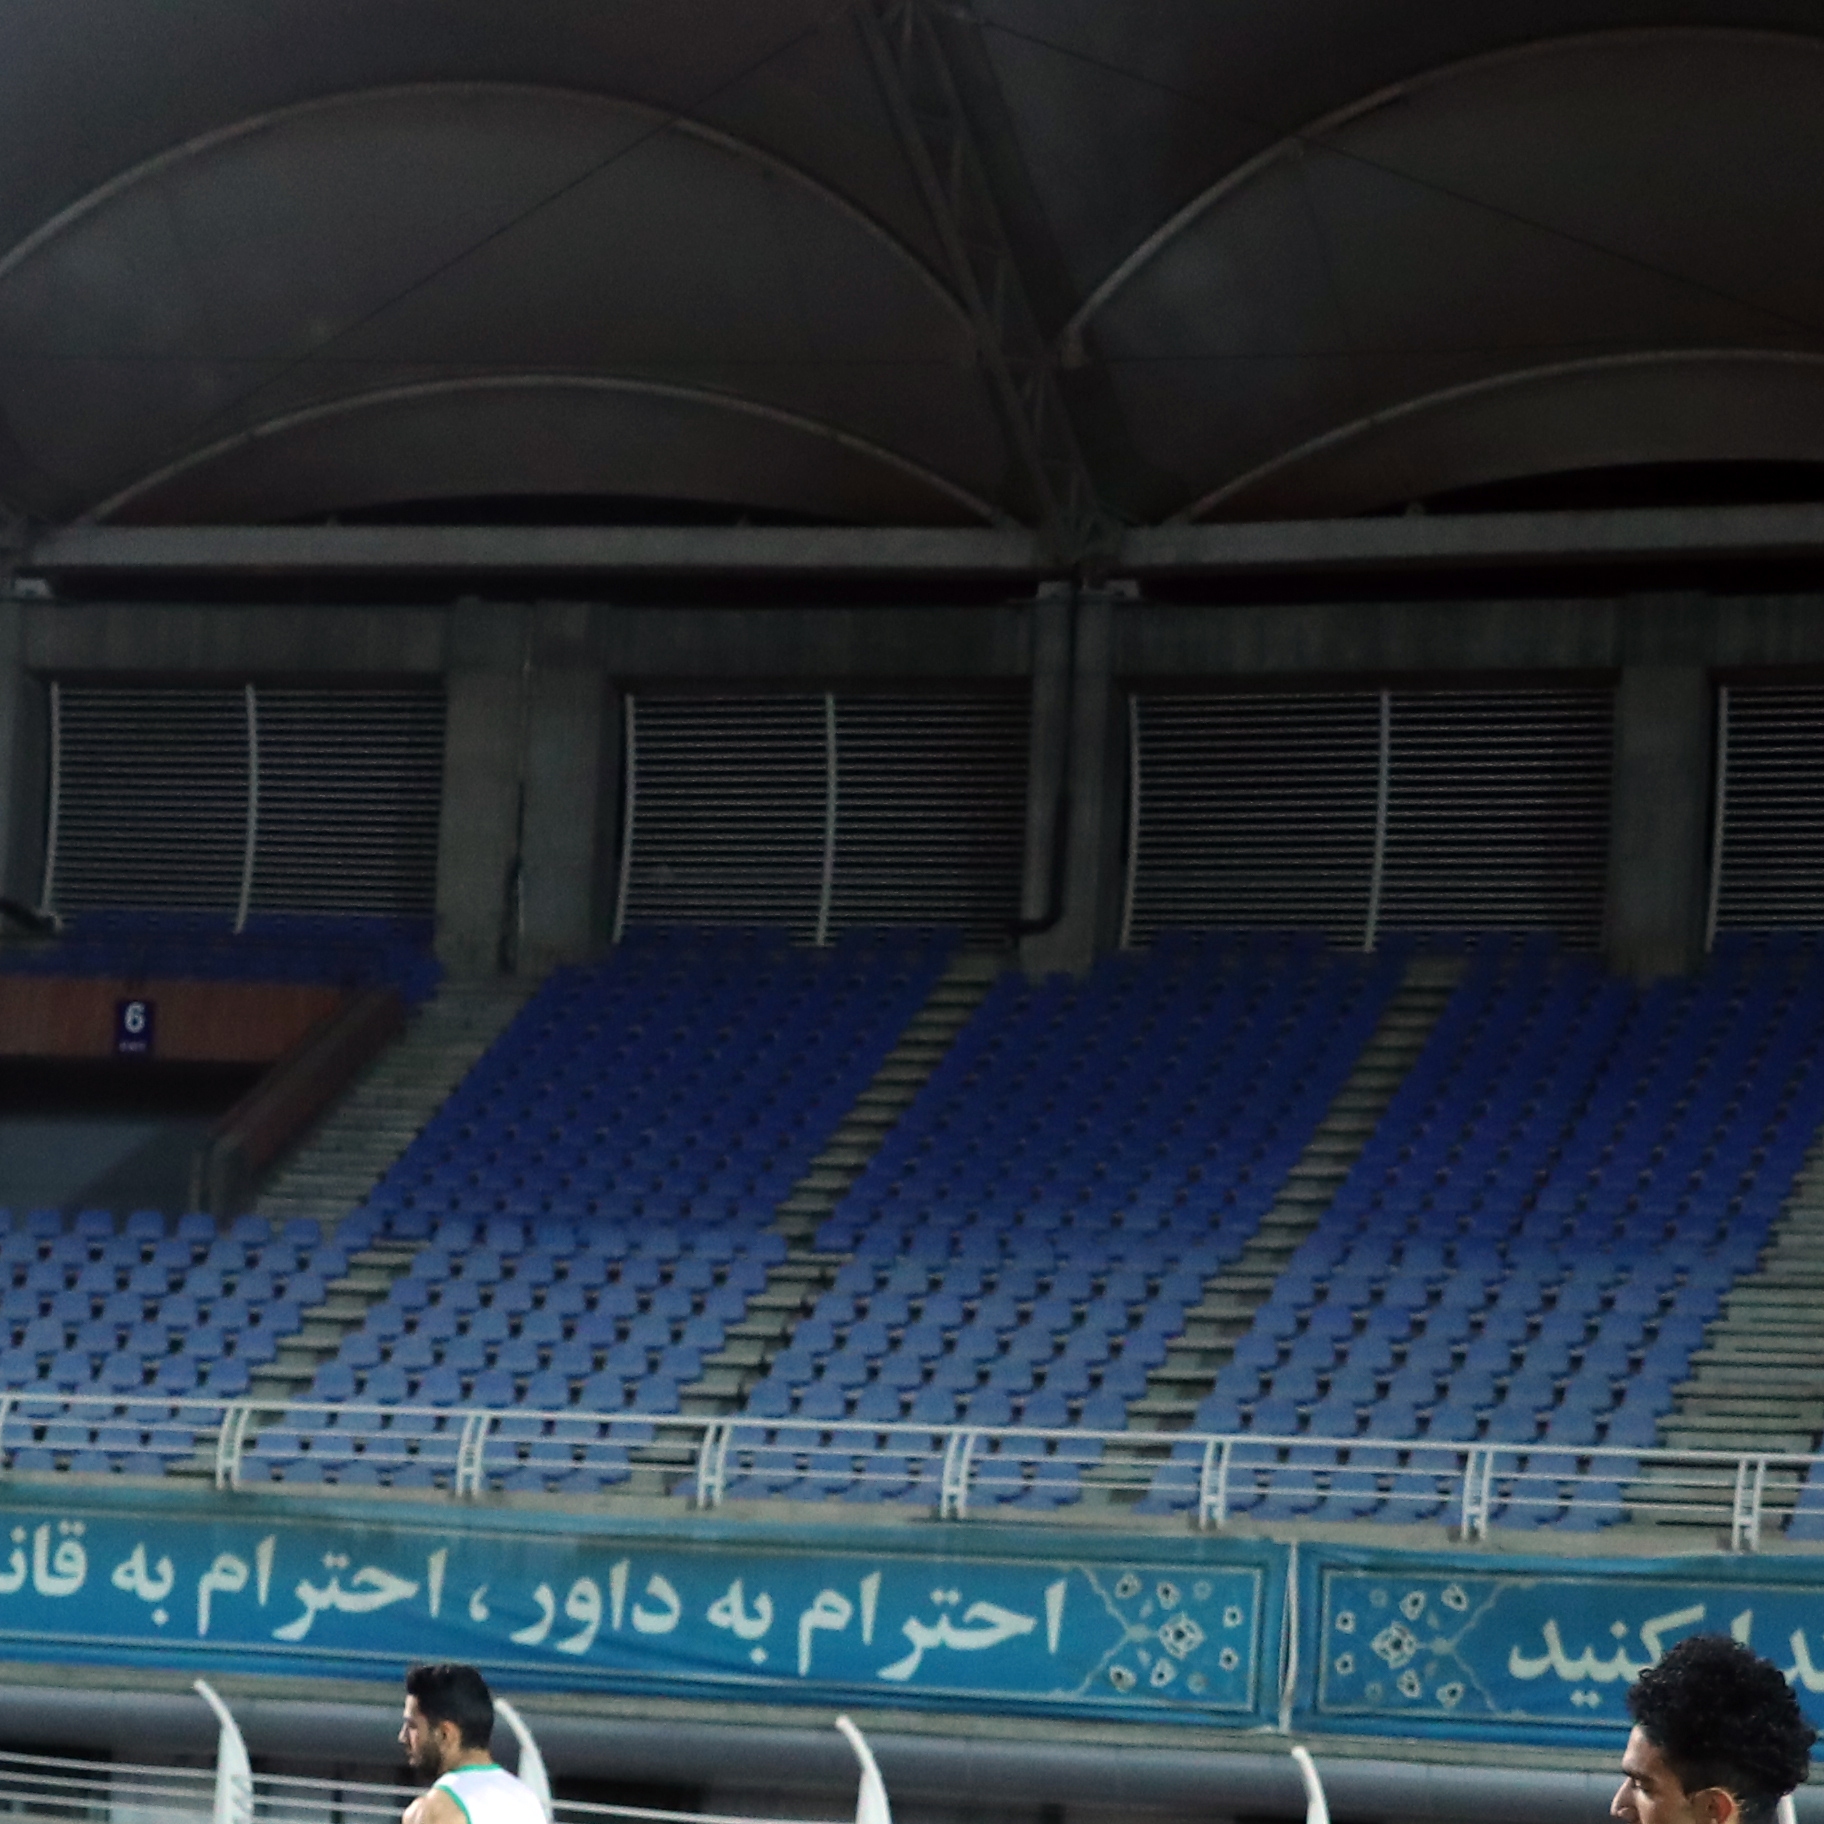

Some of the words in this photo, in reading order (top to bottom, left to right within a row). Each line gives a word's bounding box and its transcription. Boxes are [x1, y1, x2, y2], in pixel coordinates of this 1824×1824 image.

[124, 1001, 146, 1034] 6
[111, 1541, 174, 1626] به
[198, 1534, 448, 1642] احترام
[706, 1577, 774, 1664] به
[798, 1570, 1067, 1681] احترام
